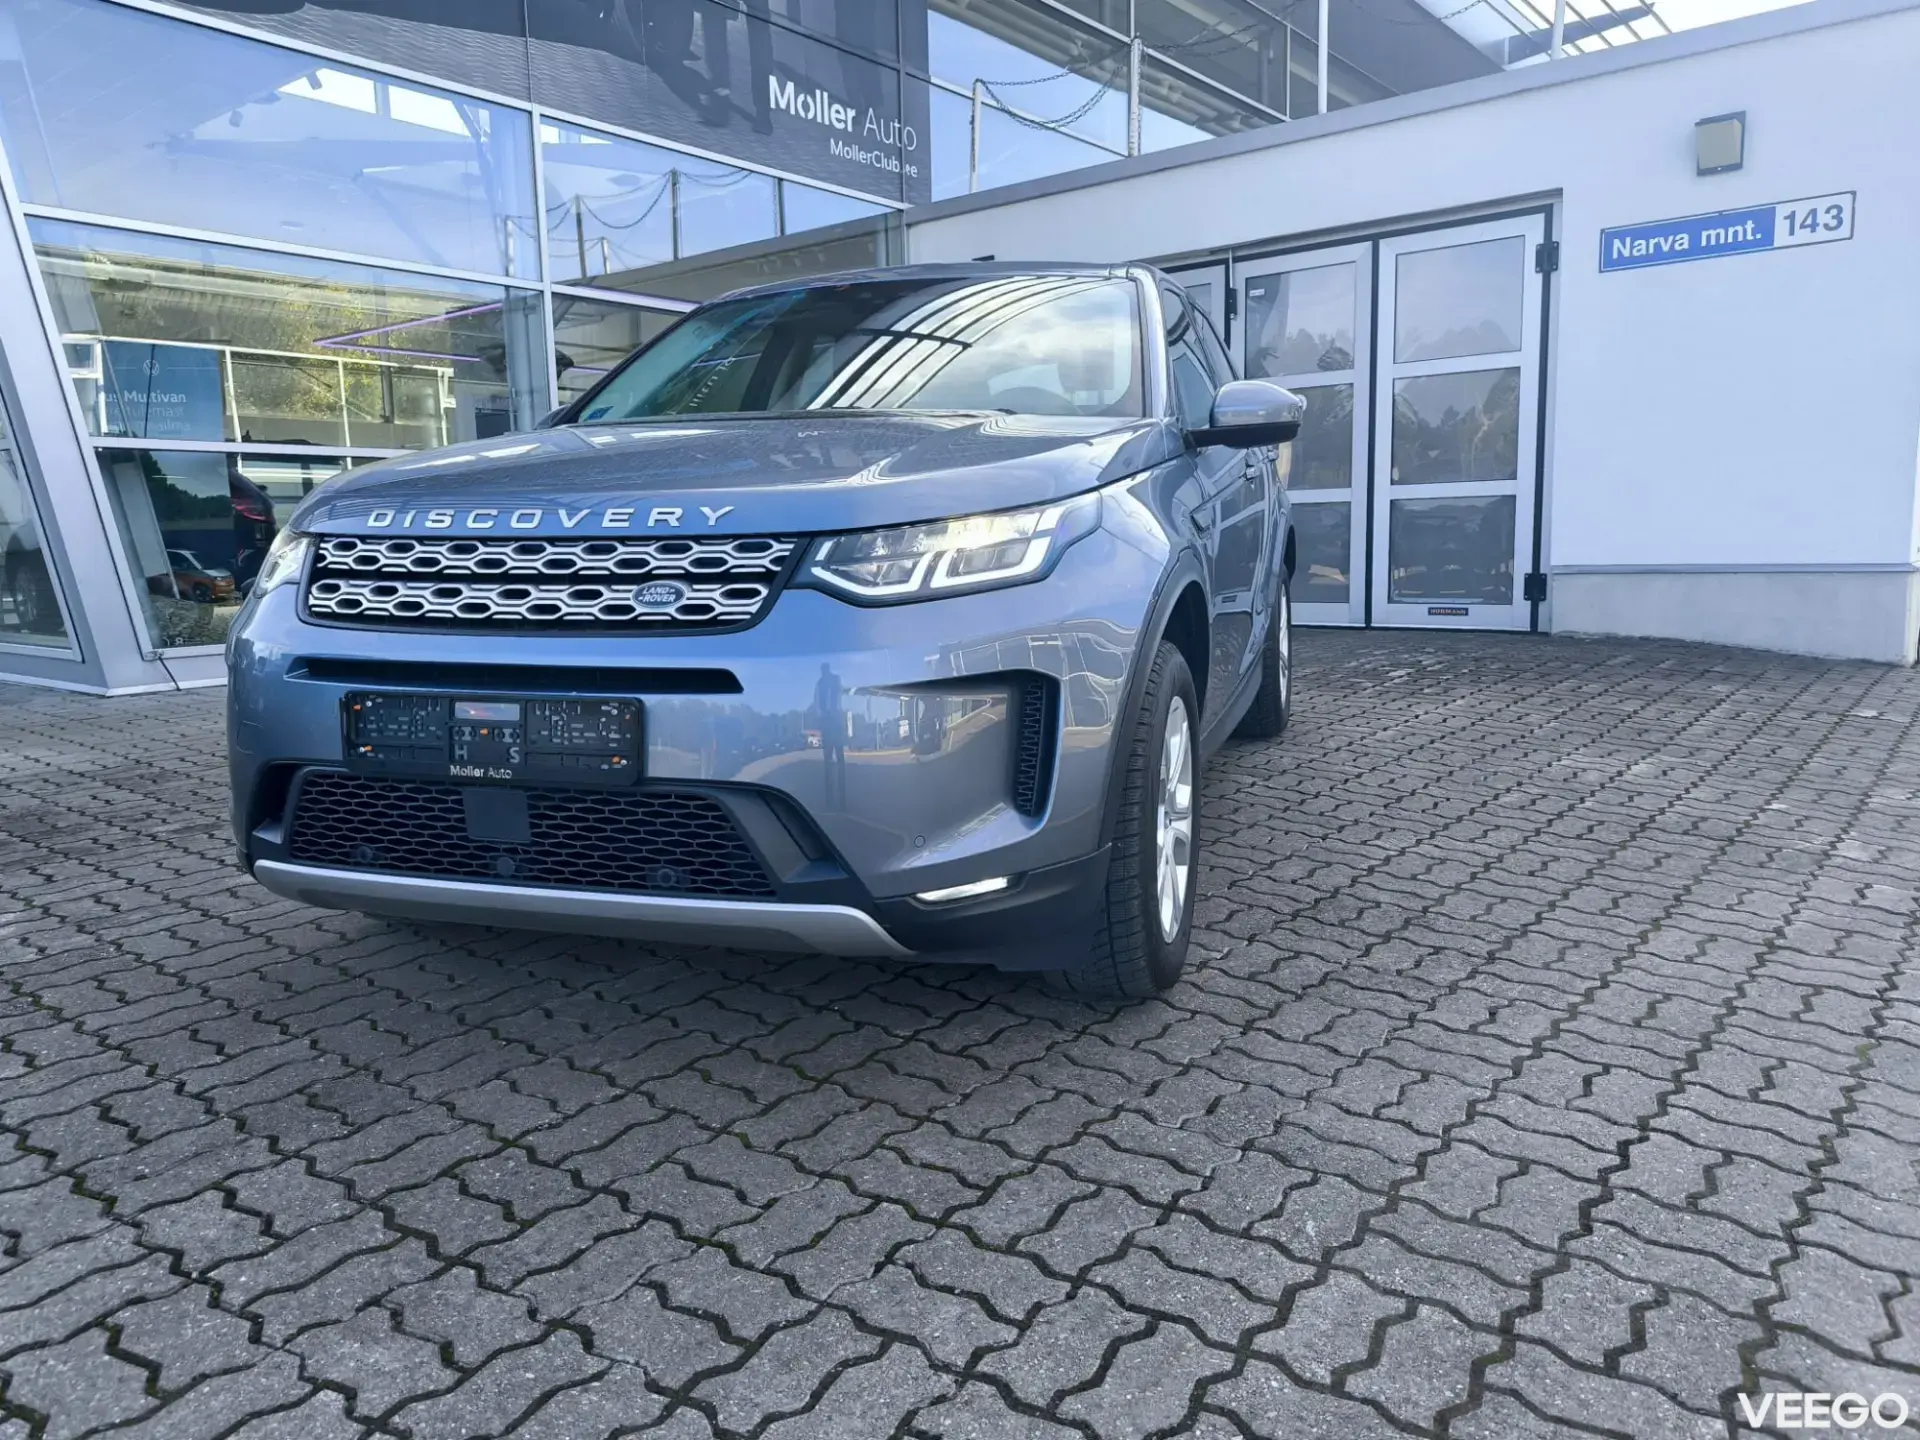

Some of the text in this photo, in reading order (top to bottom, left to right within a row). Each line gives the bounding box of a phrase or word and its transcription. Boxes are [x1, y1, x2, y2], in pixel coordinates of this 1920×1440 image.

[863, 107, 917, 150] Auto
[1611, 203, 1845, 260] Narva mnt. 143
[123, 389, 187, 403] Mutivan
[366, 506, 735, 530] DISCOVERY
[643, 586, 670, 595] LAND
[643, 594, 676, 603] ROVER
[488, 768, 513, 780] Auto
